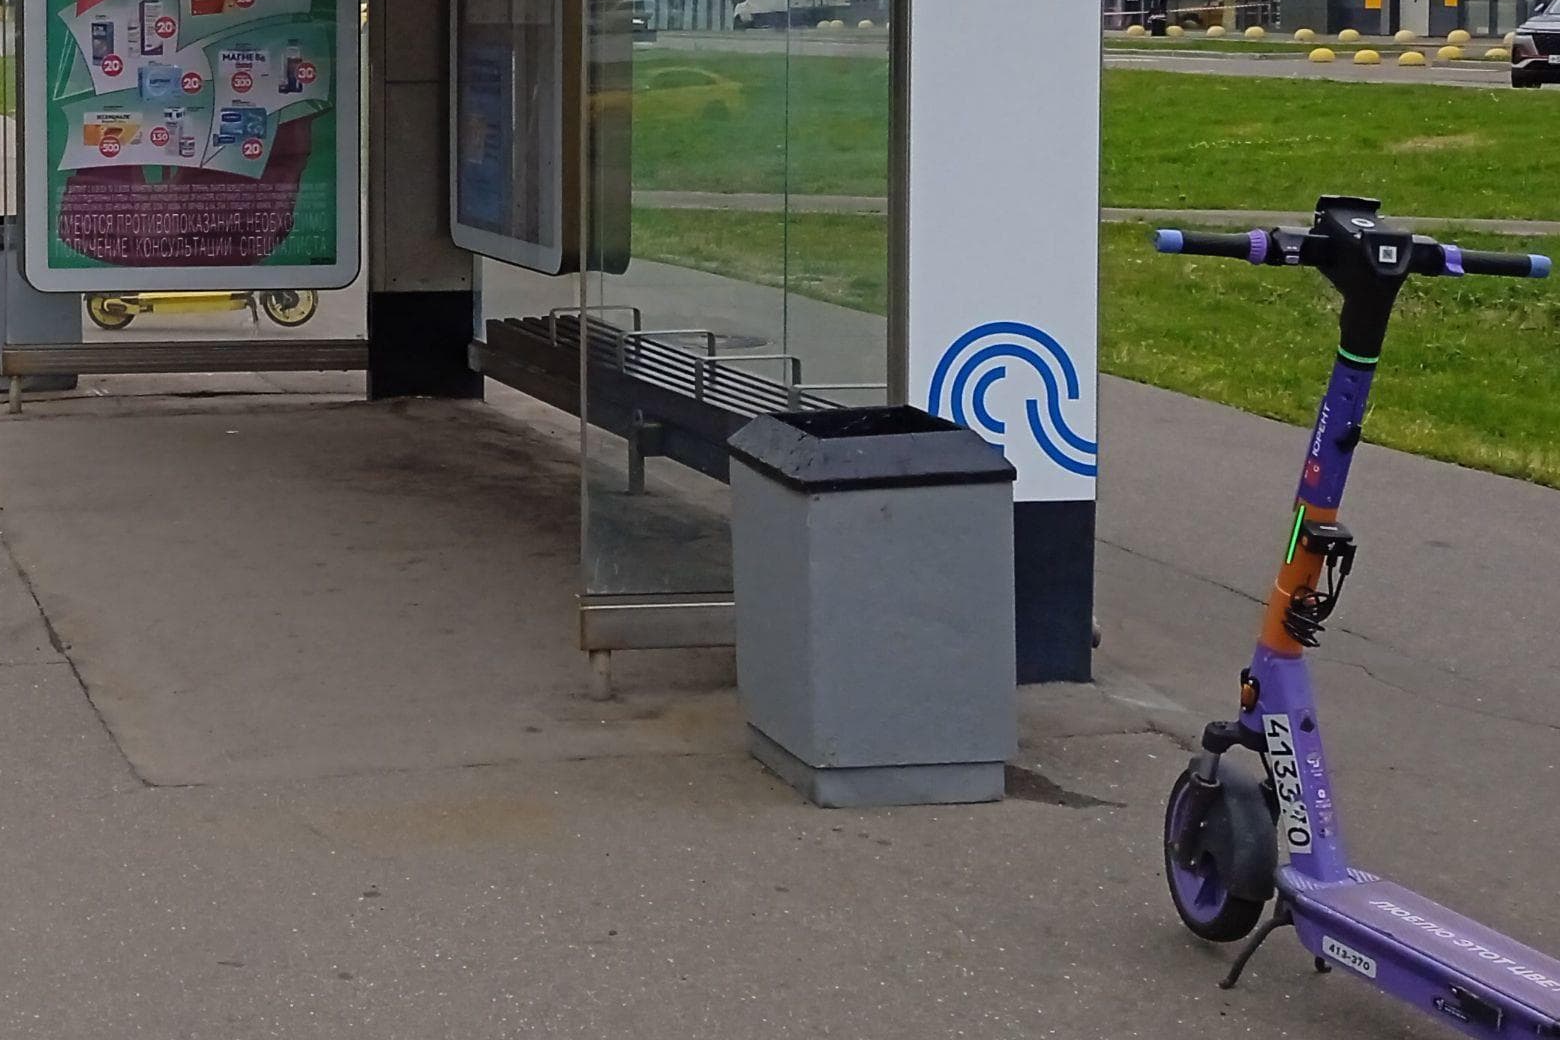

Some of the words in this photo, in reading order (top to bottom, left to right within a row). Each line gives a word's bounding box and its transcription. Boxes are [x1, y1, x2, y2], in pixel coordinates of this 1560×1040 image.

[56, 214, 113, 235] ИМЕЮТСЯ
[56, 237, 128, 258] ПОЛУЧЕНИЕ
[136, 236, 232, 258] КОНСУЛЬТАЦИИ
[1328, 943, 1371, 972] 413-370
[1369, 900, 1456, 939] ЛЮБЛЮ
[1452, 937, 1517, 965] ЭТОТ
[1507, 965, 1560, 993] ЦВЕ
